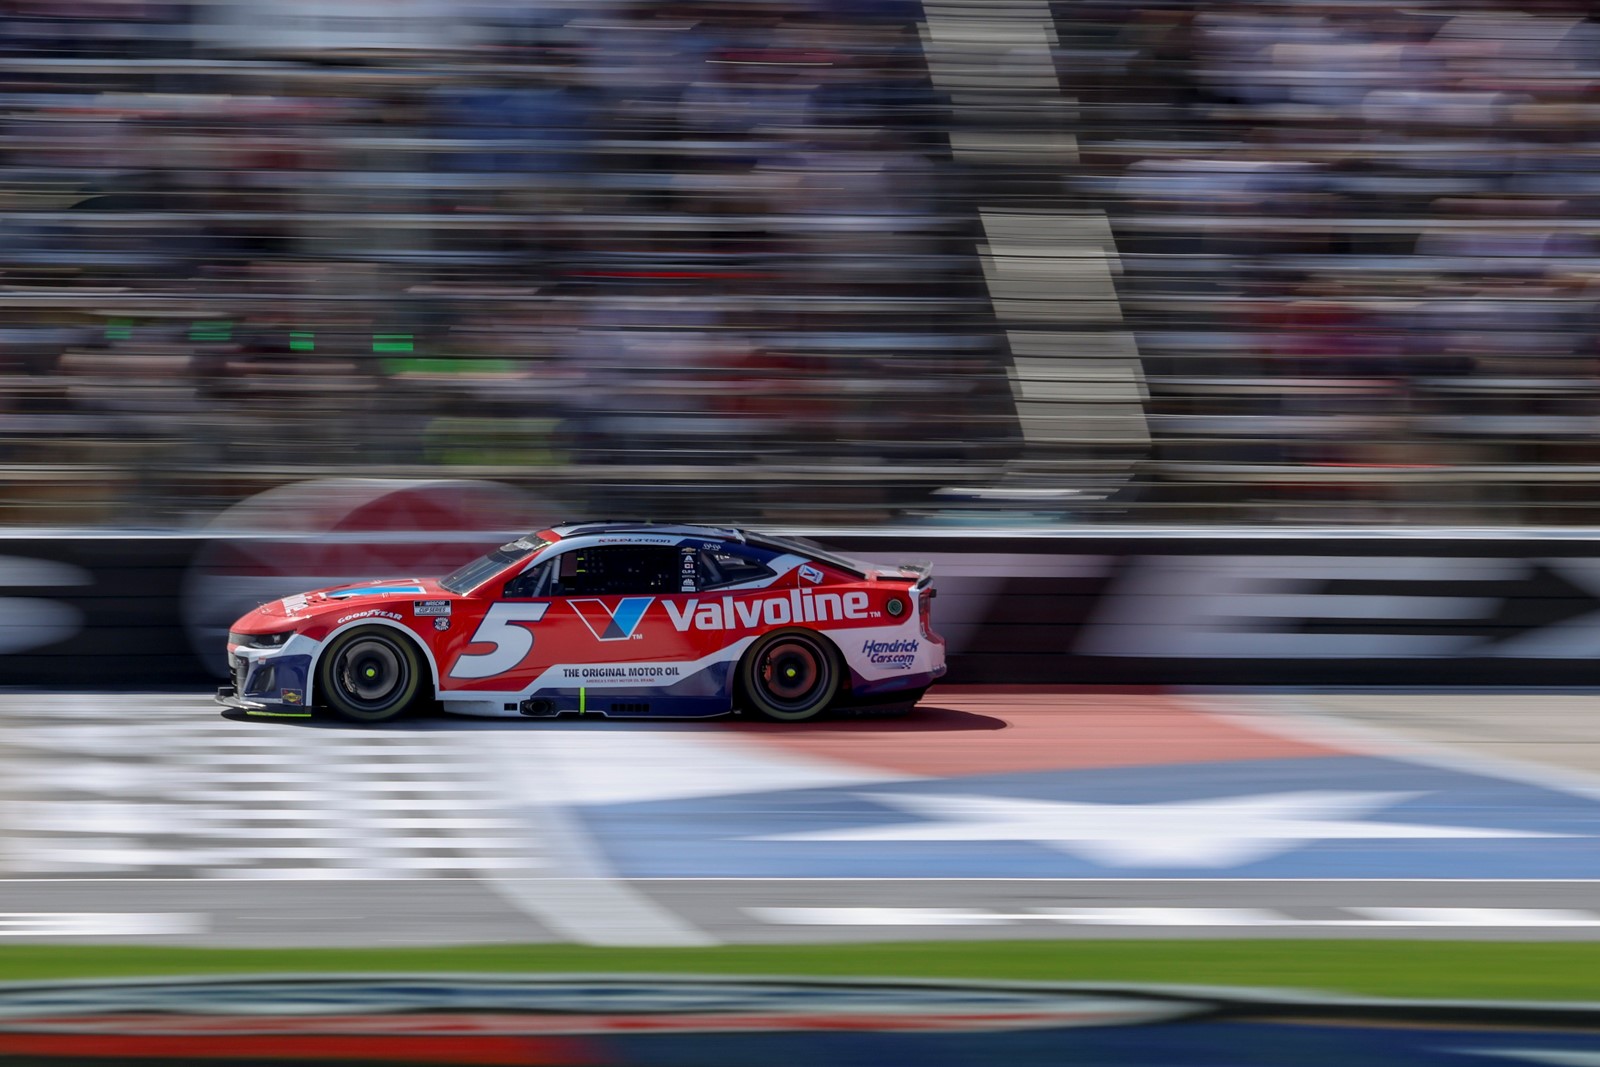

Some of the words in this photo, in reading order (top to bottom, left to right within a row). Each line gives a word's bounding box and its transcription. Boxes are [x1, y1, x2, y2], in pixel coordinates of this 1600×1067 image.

[337, 609, 403, 623] GOODYEAR
[661, 588, 869, 632] Valvoline
[449, 601, 551, 679] 5
[862, 639, 919, 657] Hendrick
[870, 653, 915, 663] Cars.com
[563, 668, 580, 677] THE
[582, 668, 626, 677] ORIGINAL
[628, 667, 663, 676] MOTOR
[665, 667, 680, 676] OIL
